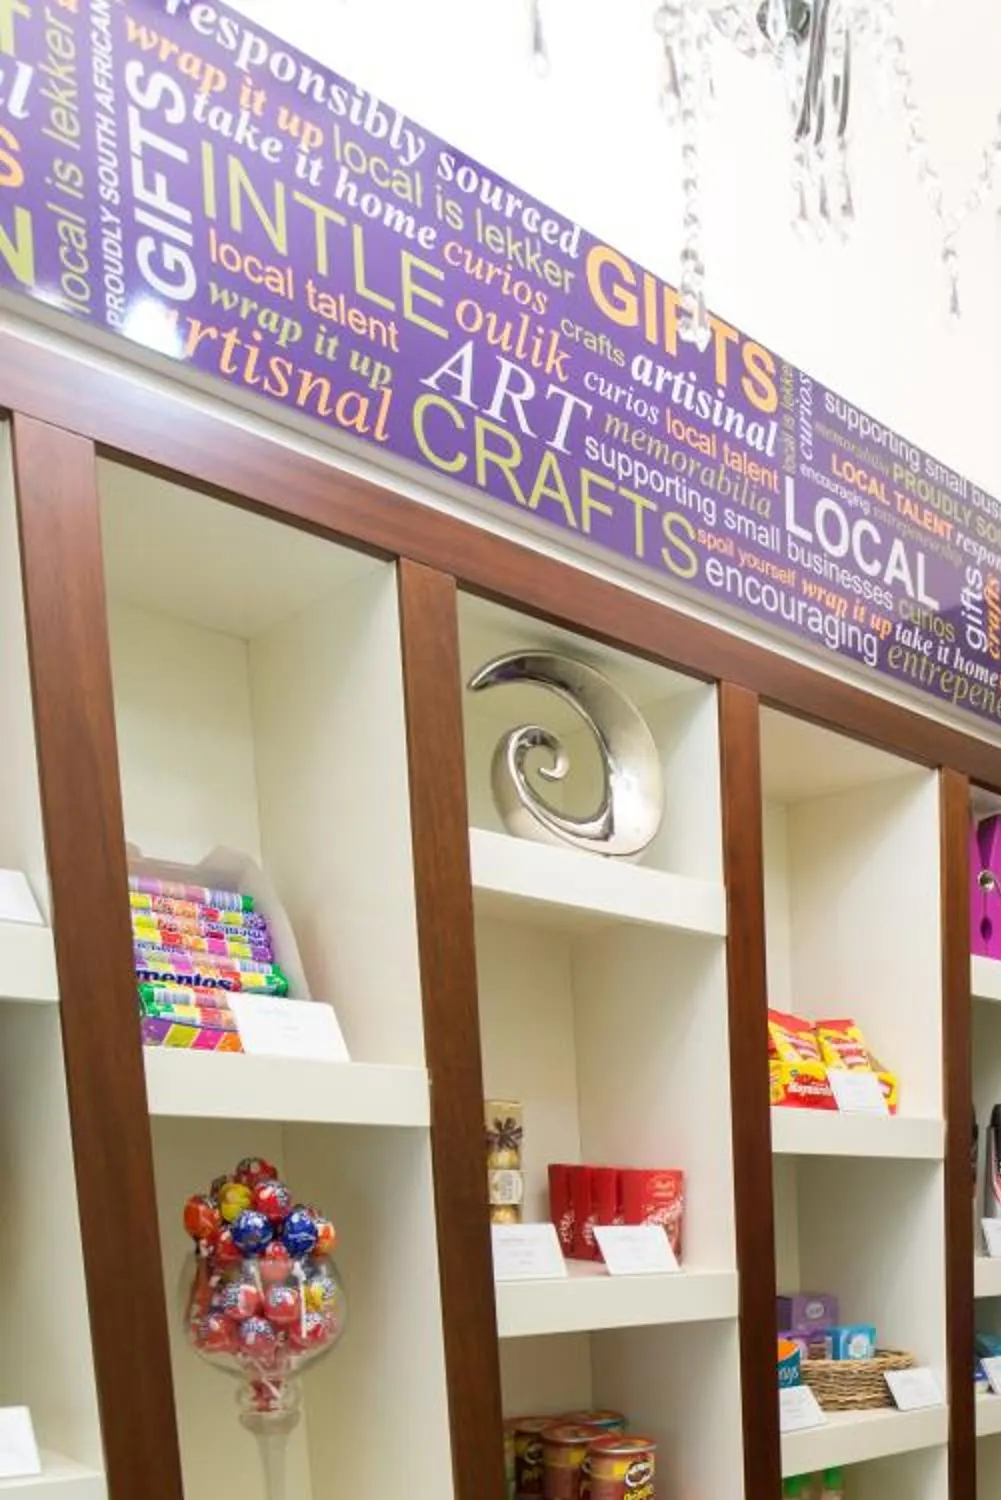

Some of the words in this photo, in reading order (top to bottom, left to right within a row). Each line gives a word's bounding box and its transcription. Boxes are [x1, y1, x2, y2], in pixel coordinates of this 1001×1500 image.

[38, 5, 80, 150] lekker
[90, 0, 116, 113] AFRICAN
[125, 16, 227, 93] wrap
[240, 76, 265, 117] it
[277, 104, 324, 150] up
[45, 157, 84, 199] is
[96, 114, 121, 205] SOUTH
[125, 60, 198, 301] GIFTS
[166, 0, 425, 166] responsibly
[437, 151, 582, 259] sourced
[193, 94, 283, 163] take
[294, 142, 322, 186] it
[335, 172, 437, 250] home
[46, 202, 92, 314] local
[200, 140, 449, 340] INTLE
[333, 123, 422, 208] local
[436, 184, 464, 230] is
[476, 206, 574, 293] lekker
[99, 205, 126, 327] PROUDLY
[209, 227, 294, 300] local
[305, 279, 400, 352] talent
[443, 239, 549, 315] curios
[163, 306, 393, 442] rtisnal
[209, 281, 303, 348] wrap
[314, 324, 340, 362] it
[350, 350, 393, 390] up
[455, 298, 574, 384] oulik
[559, 315, 626, 369] crafts
[420, 339, 593, 456] ART
[584, 369, 659, 425] curios
[631, 352, 778, 458] artisinal
[796, 373, 814, 462] curios
[824, 391, 920, 471] supporting
[925, 458, 967, 497] small
[412, 392, 699, 579] CRAFTS
[604, 412, 772, 519] memorabilia
[665, 407, 717, 458] local
[723, 442, 780, 494] talent
[800, 463, 871, 516] encouraging
[831, 452, 890, 506] LOCAL
[894, 490, 956, 541] TALENT
[892, 462, 973, 527] PROUDLY
[584, 434, 716, 524] supporting
[723, 508, 781, 553] small
[786, 536, 894, 612] businesses
[696, 528, 735, 558] spoil
[737, 545, 796, 587] yourself
[785, 476, 940, 610] LOCAL
[705, 557, 878, 667] encouraging
[801, 577, 848, 620] wrap
[852, 603, 866, 624] it
[869, 612, 892, 640] up
[895, 622, 932, 656] take
[937, 639, 950, 664] it
[953, 645, 999, 687] home
[898, 600, 956, 643] curios
[960, 566, 988, 652] gifts
[135, 969, 234, 992] mentos
